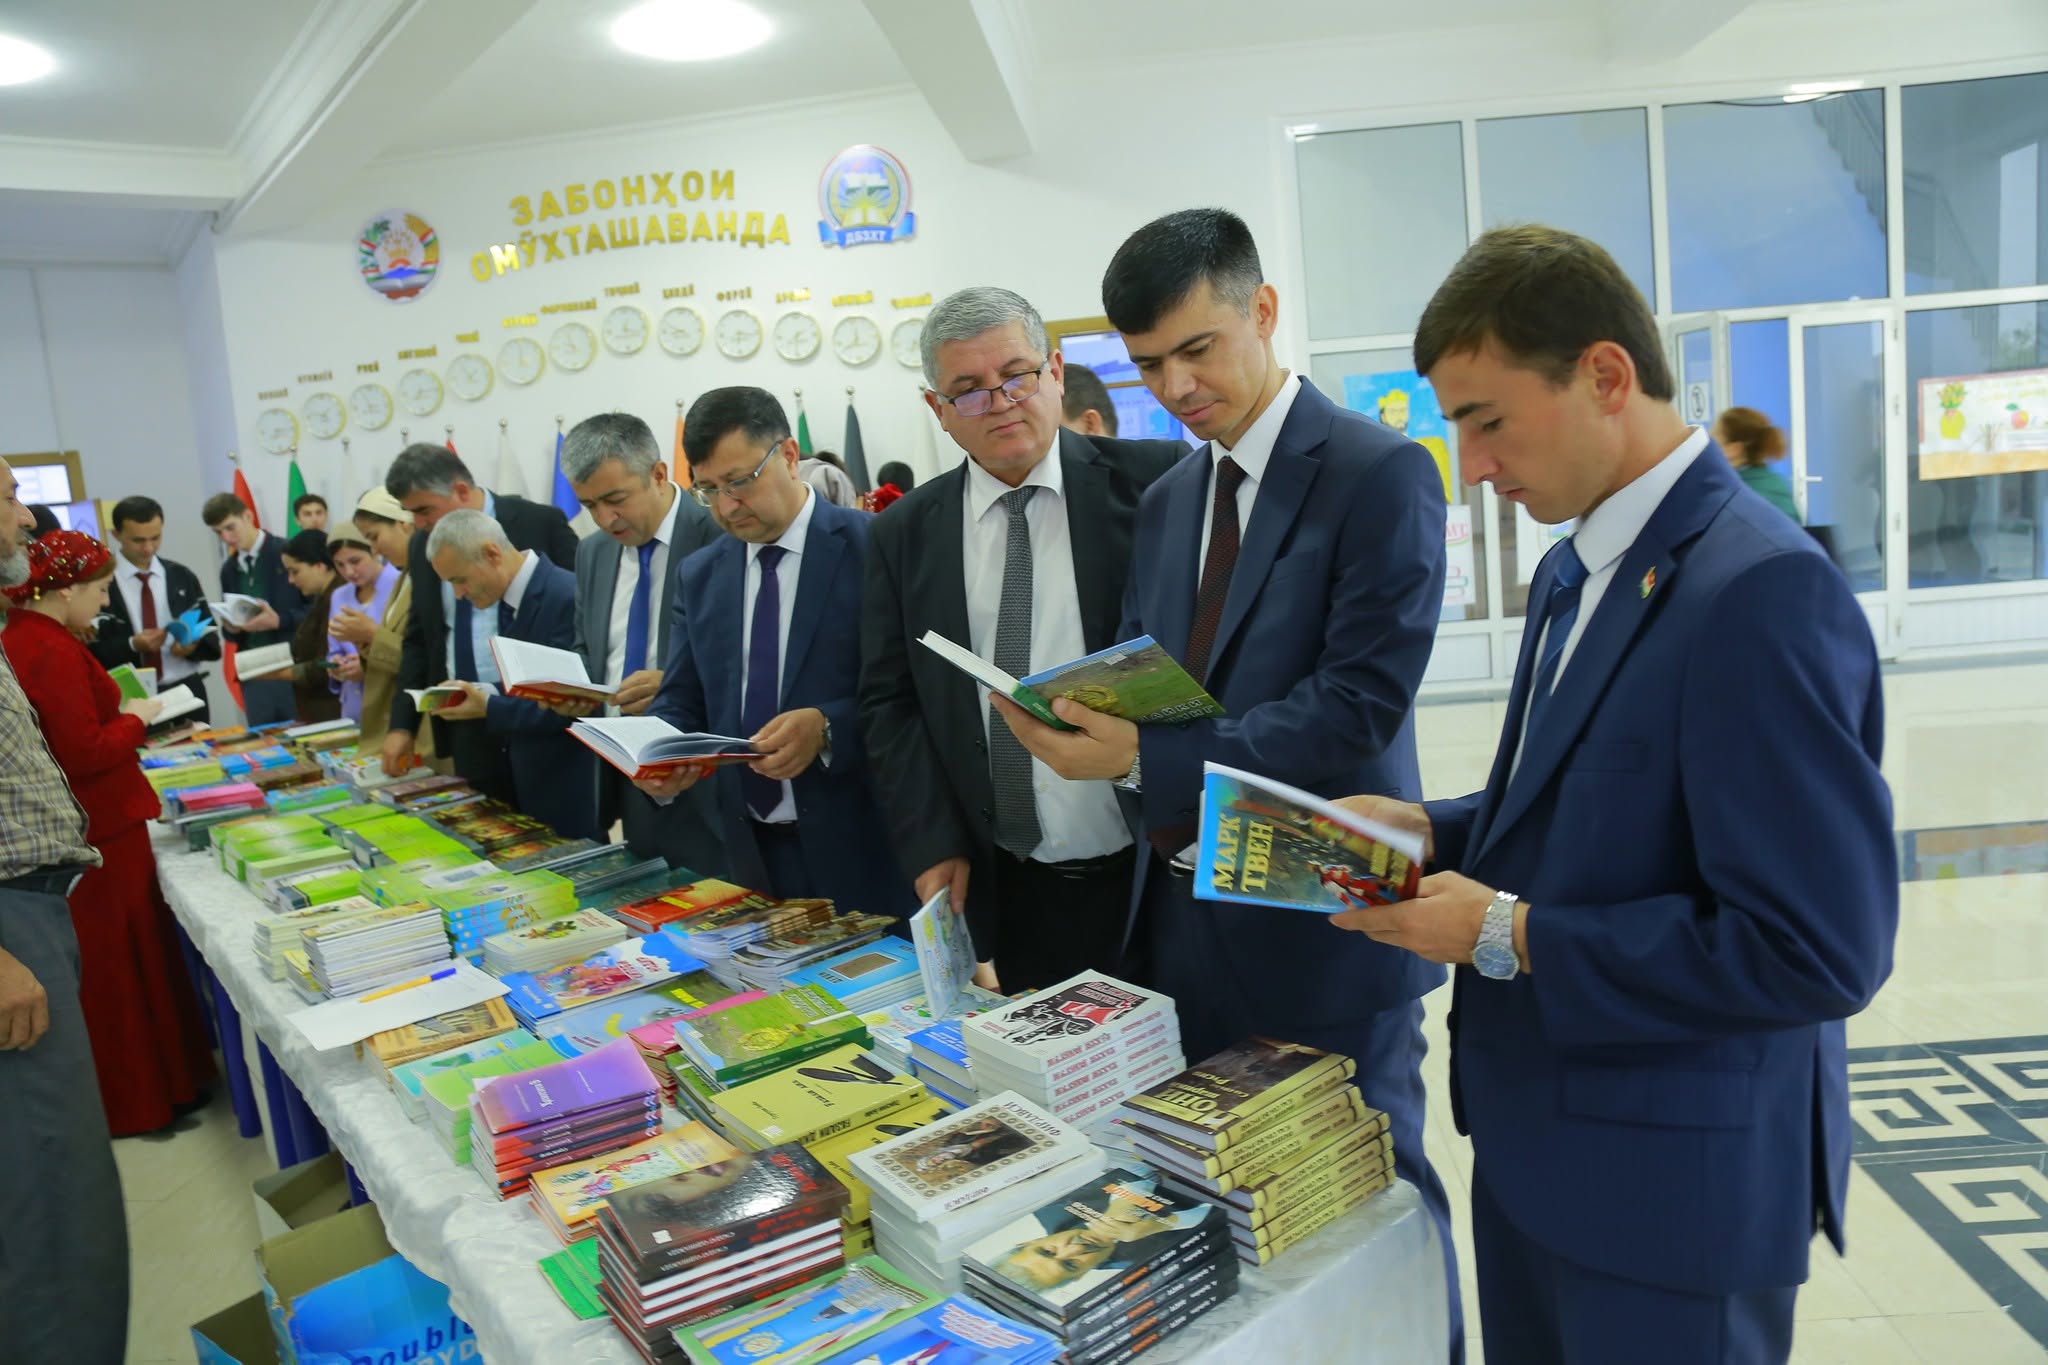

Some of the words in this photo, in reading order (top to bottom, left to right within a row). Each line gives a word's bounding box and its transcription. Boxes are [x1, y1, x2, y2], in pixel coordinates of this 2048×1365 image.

[509, 169, 735, 226] ЗАБОНҲОИ
[1212, 812, 1242, 891] МАРК
[1240, 820, 1275, 893] ТВЕН
